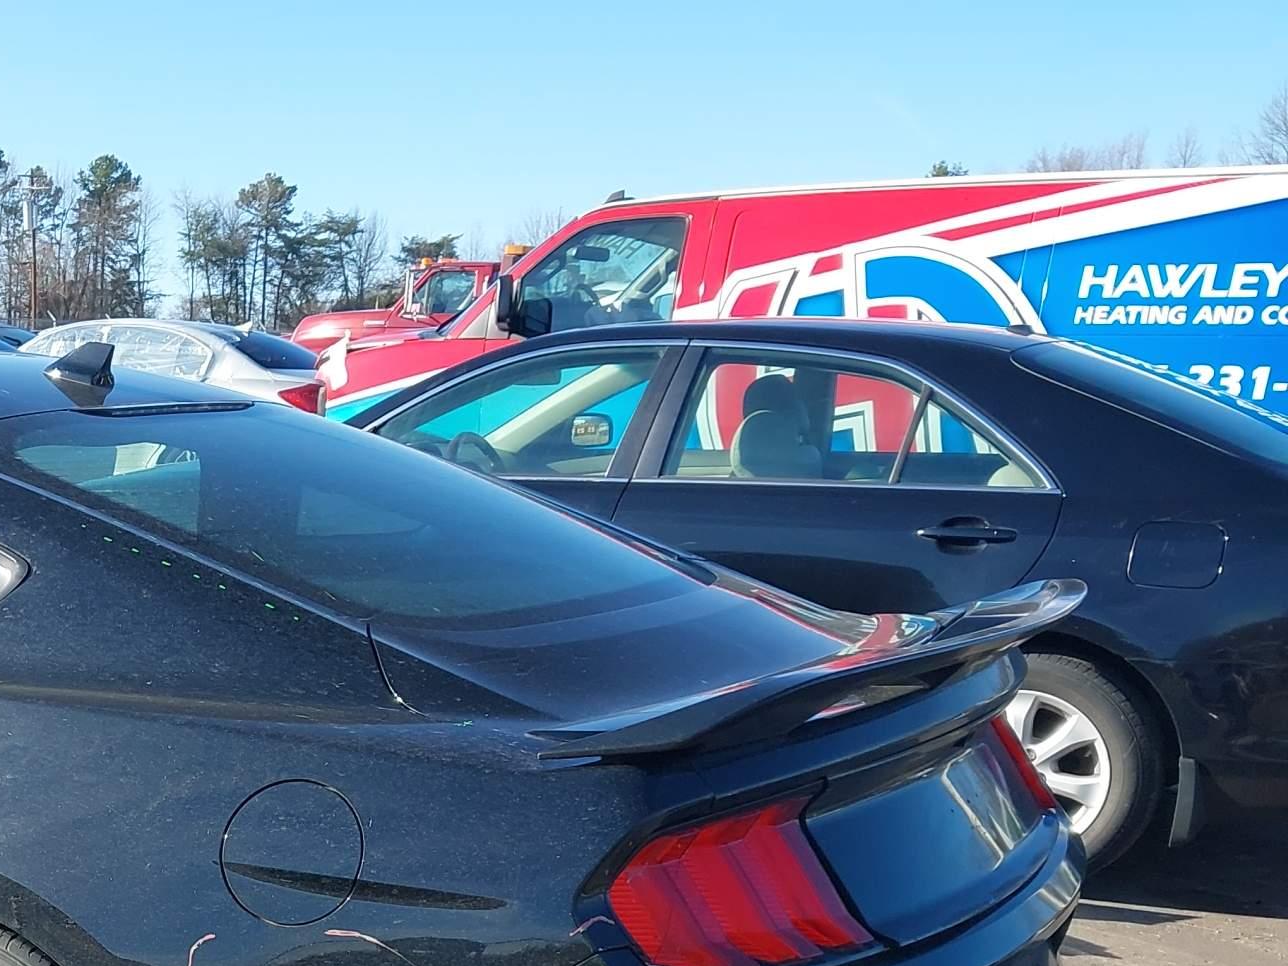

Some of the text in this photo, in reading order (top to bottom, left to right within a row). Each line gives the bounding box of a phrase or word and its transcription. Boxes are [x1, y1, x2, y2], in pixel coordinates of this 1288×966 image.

[1077, 262, 1288, 299] HAWLEY
[1073, 304, 1188, 326] HEATING
[1191, 304, 1254, 326] AND
